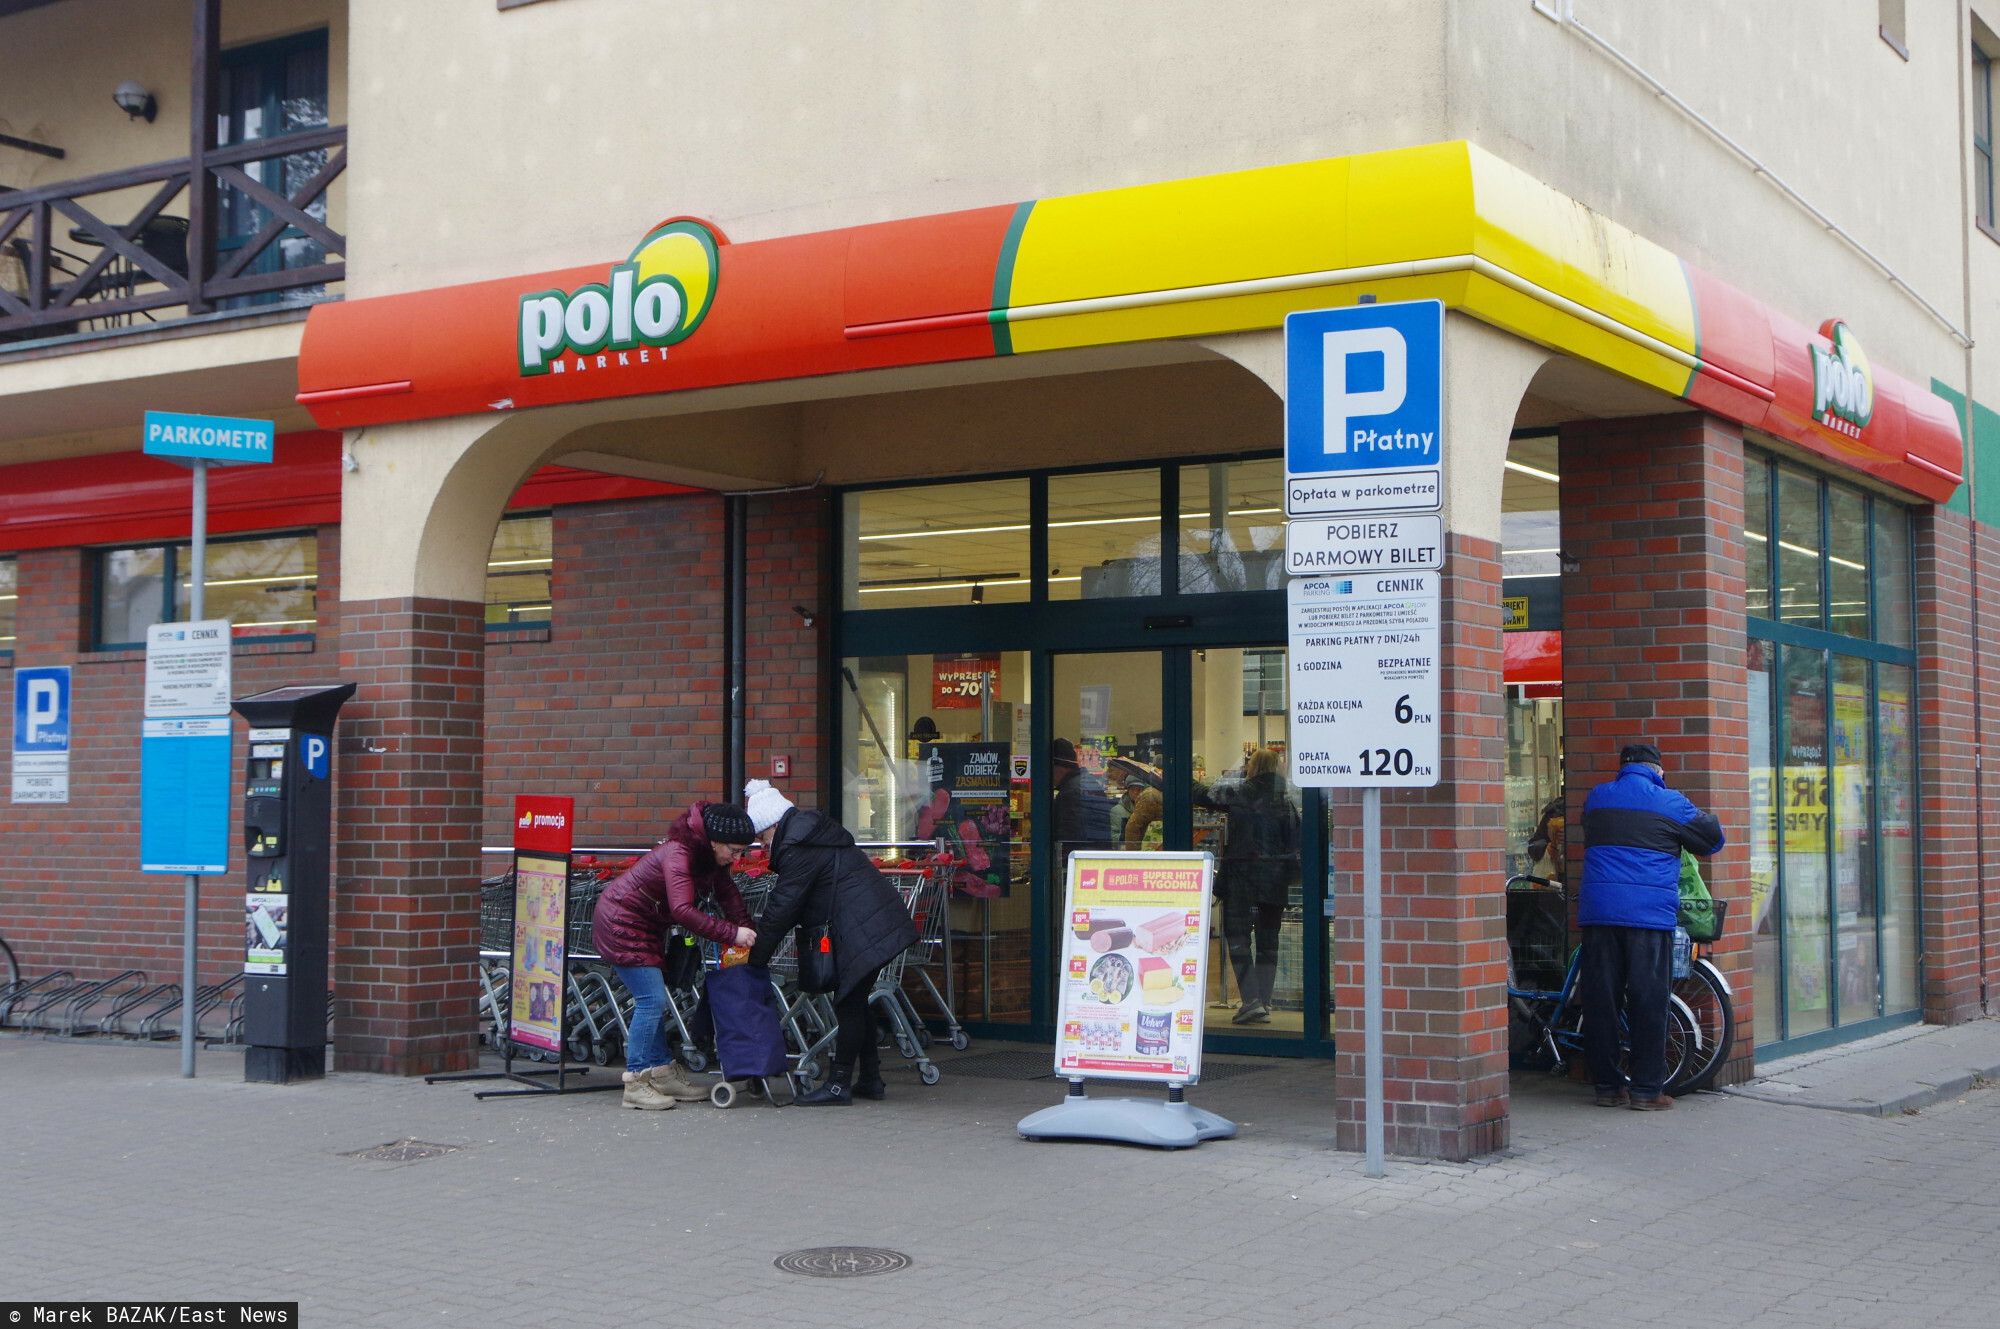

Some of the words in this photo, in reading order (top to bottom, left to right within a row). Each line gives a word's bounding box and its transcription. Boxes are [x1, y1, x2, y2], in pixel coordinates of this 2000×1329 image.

[522, 269, 682, 367] polo
[553, 346, 669, 374] MARKET
[1817, 345, 1867, 417] polo
[1323, 326, 1407, 455] P
[1822, 413, 1861, 439] MARKET
[149, 424, 268, 450] PARKOMETR
[1353, 428, 1434, 455] Płatny
[1292, 487, 1336, 503] Opłata
[1341, 489, 1351, 498] w
[1356, 483, 1436, 500] parkometrze
[1327, 523, 1399, 540] POBIERZ
[1293, 549, 1383, 567] DARMOWY
[1390, 547, 1436, 563] BILET
[1304, 582, 1330, 590] APCOA
[1377, 579, 1424, 592] CENNIK
[1303, 589, 1331, 597] PARKING
[191, 629, 219, 640] CENNIK
[1305, 637, 1342, 647] PARKING
[1344, 635, 1375, 645] PŁATNY
[1377, 635, 1382, 644] 7
[1385, 634, 1420, 644] DNI/24h
[1297, 663, 1302, 671] 1
[1303, 661, 1343, 671] GODZINA
[1378, 657, 1431, 668] BEZPŁATNIE
[939, 669, 997, 681] WYPRZEDŻ
[27, 678, 59, 743] P
[1297, 700, 1325, 710] KAŻDA
[1327, 700, 1363, 710] KOLEJNA
[1394, 693, 1414, 724] 6
[1414, 714, 1431, 723] PLN
[1297, 714, 1336, 724] GODZINA
[308, 738, 324, 770] P
[970, 752, 1000, 764] ZAMÓW,
[1299, 752, 1330, 761] OPŁATA
[1358, 748, 1414, 776] 120
[1414, 766, 1431, 775] PLN
[963, 764, 1001, 776] ODBIERZ,
[1299, 765, 1352, 775] DODATKOWA
[534, 813, 565, 829] promocja
[1142, 871, 1173, 879] SUPER
[1174, 871, 1199, 879] HITY
[1142, 880, 1199, 889] TYGODNIA
